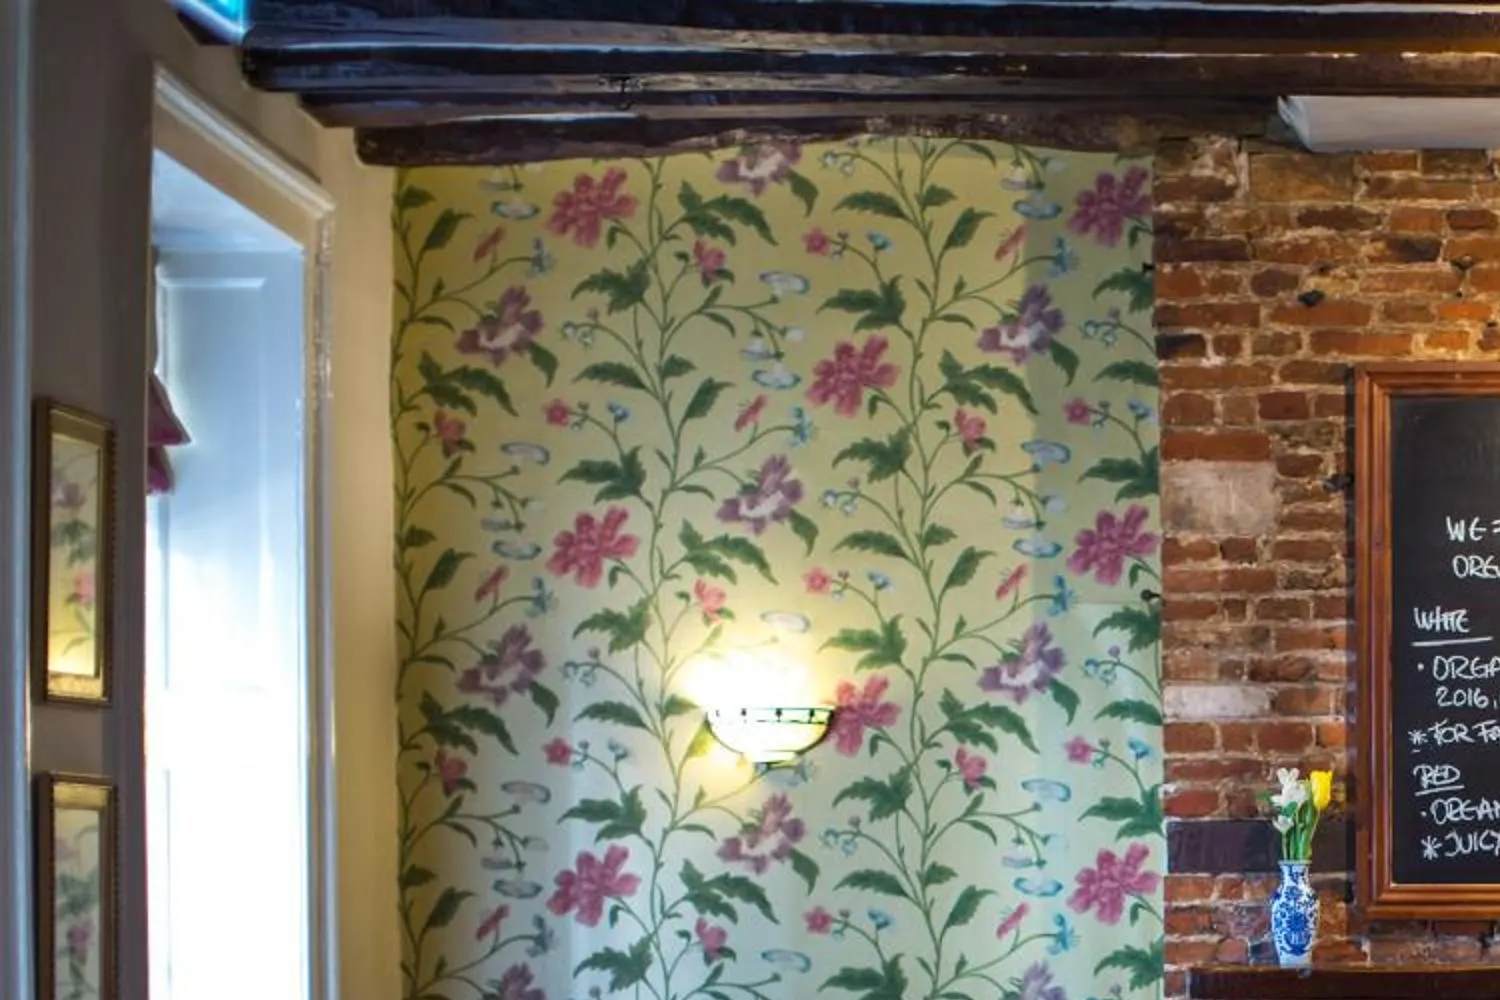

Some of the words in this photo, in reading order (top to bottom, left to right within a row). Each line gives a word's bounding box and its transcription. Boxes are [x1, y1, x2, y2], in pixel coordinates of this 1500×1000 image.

[1446, 516, 1487, 542] WE
[1413, 605, 1471, 633] WHITE
[1412, 764, 1461, 788] RED
